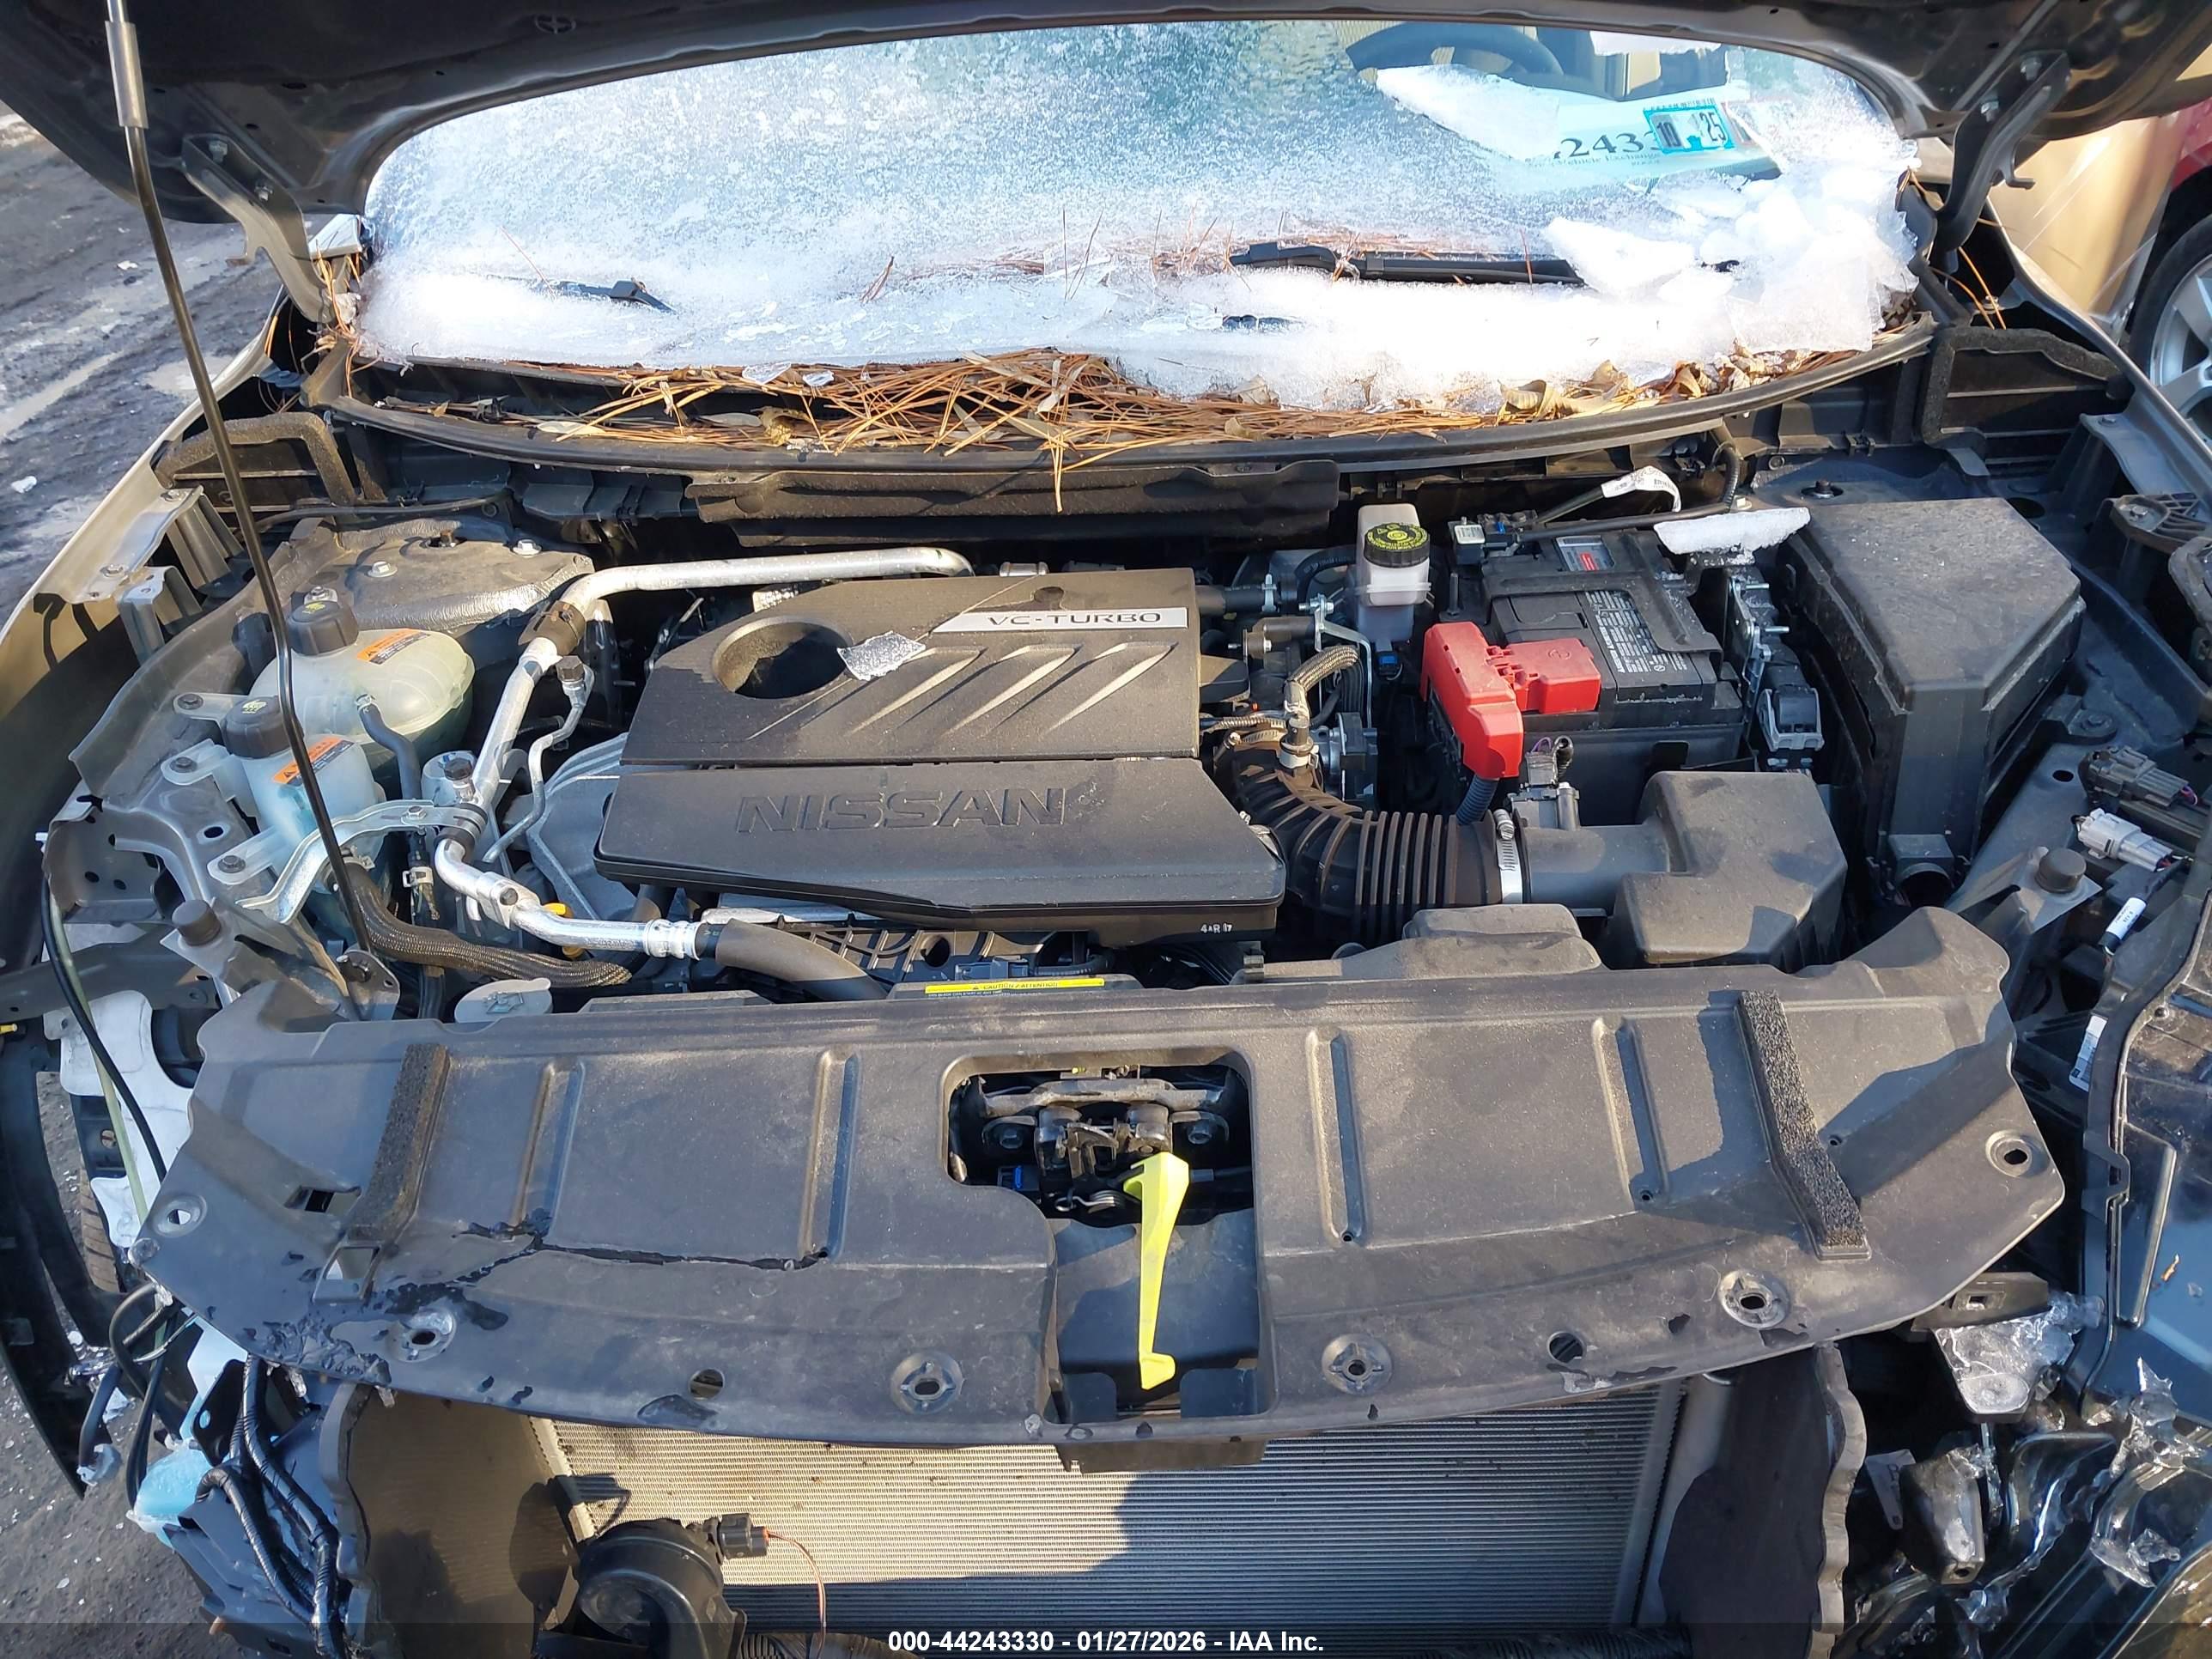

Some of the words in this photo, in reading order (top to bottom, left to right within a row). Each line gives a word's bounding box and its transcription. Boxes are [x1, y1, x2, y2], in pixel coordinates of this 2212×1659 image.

[1656, 121, 1682, 148] 10
[1699, 112, 1726, 142] 25
[988, 612, 1161, 625] VC-TURBO
[736, 787, 1066, 834] NISSAN
